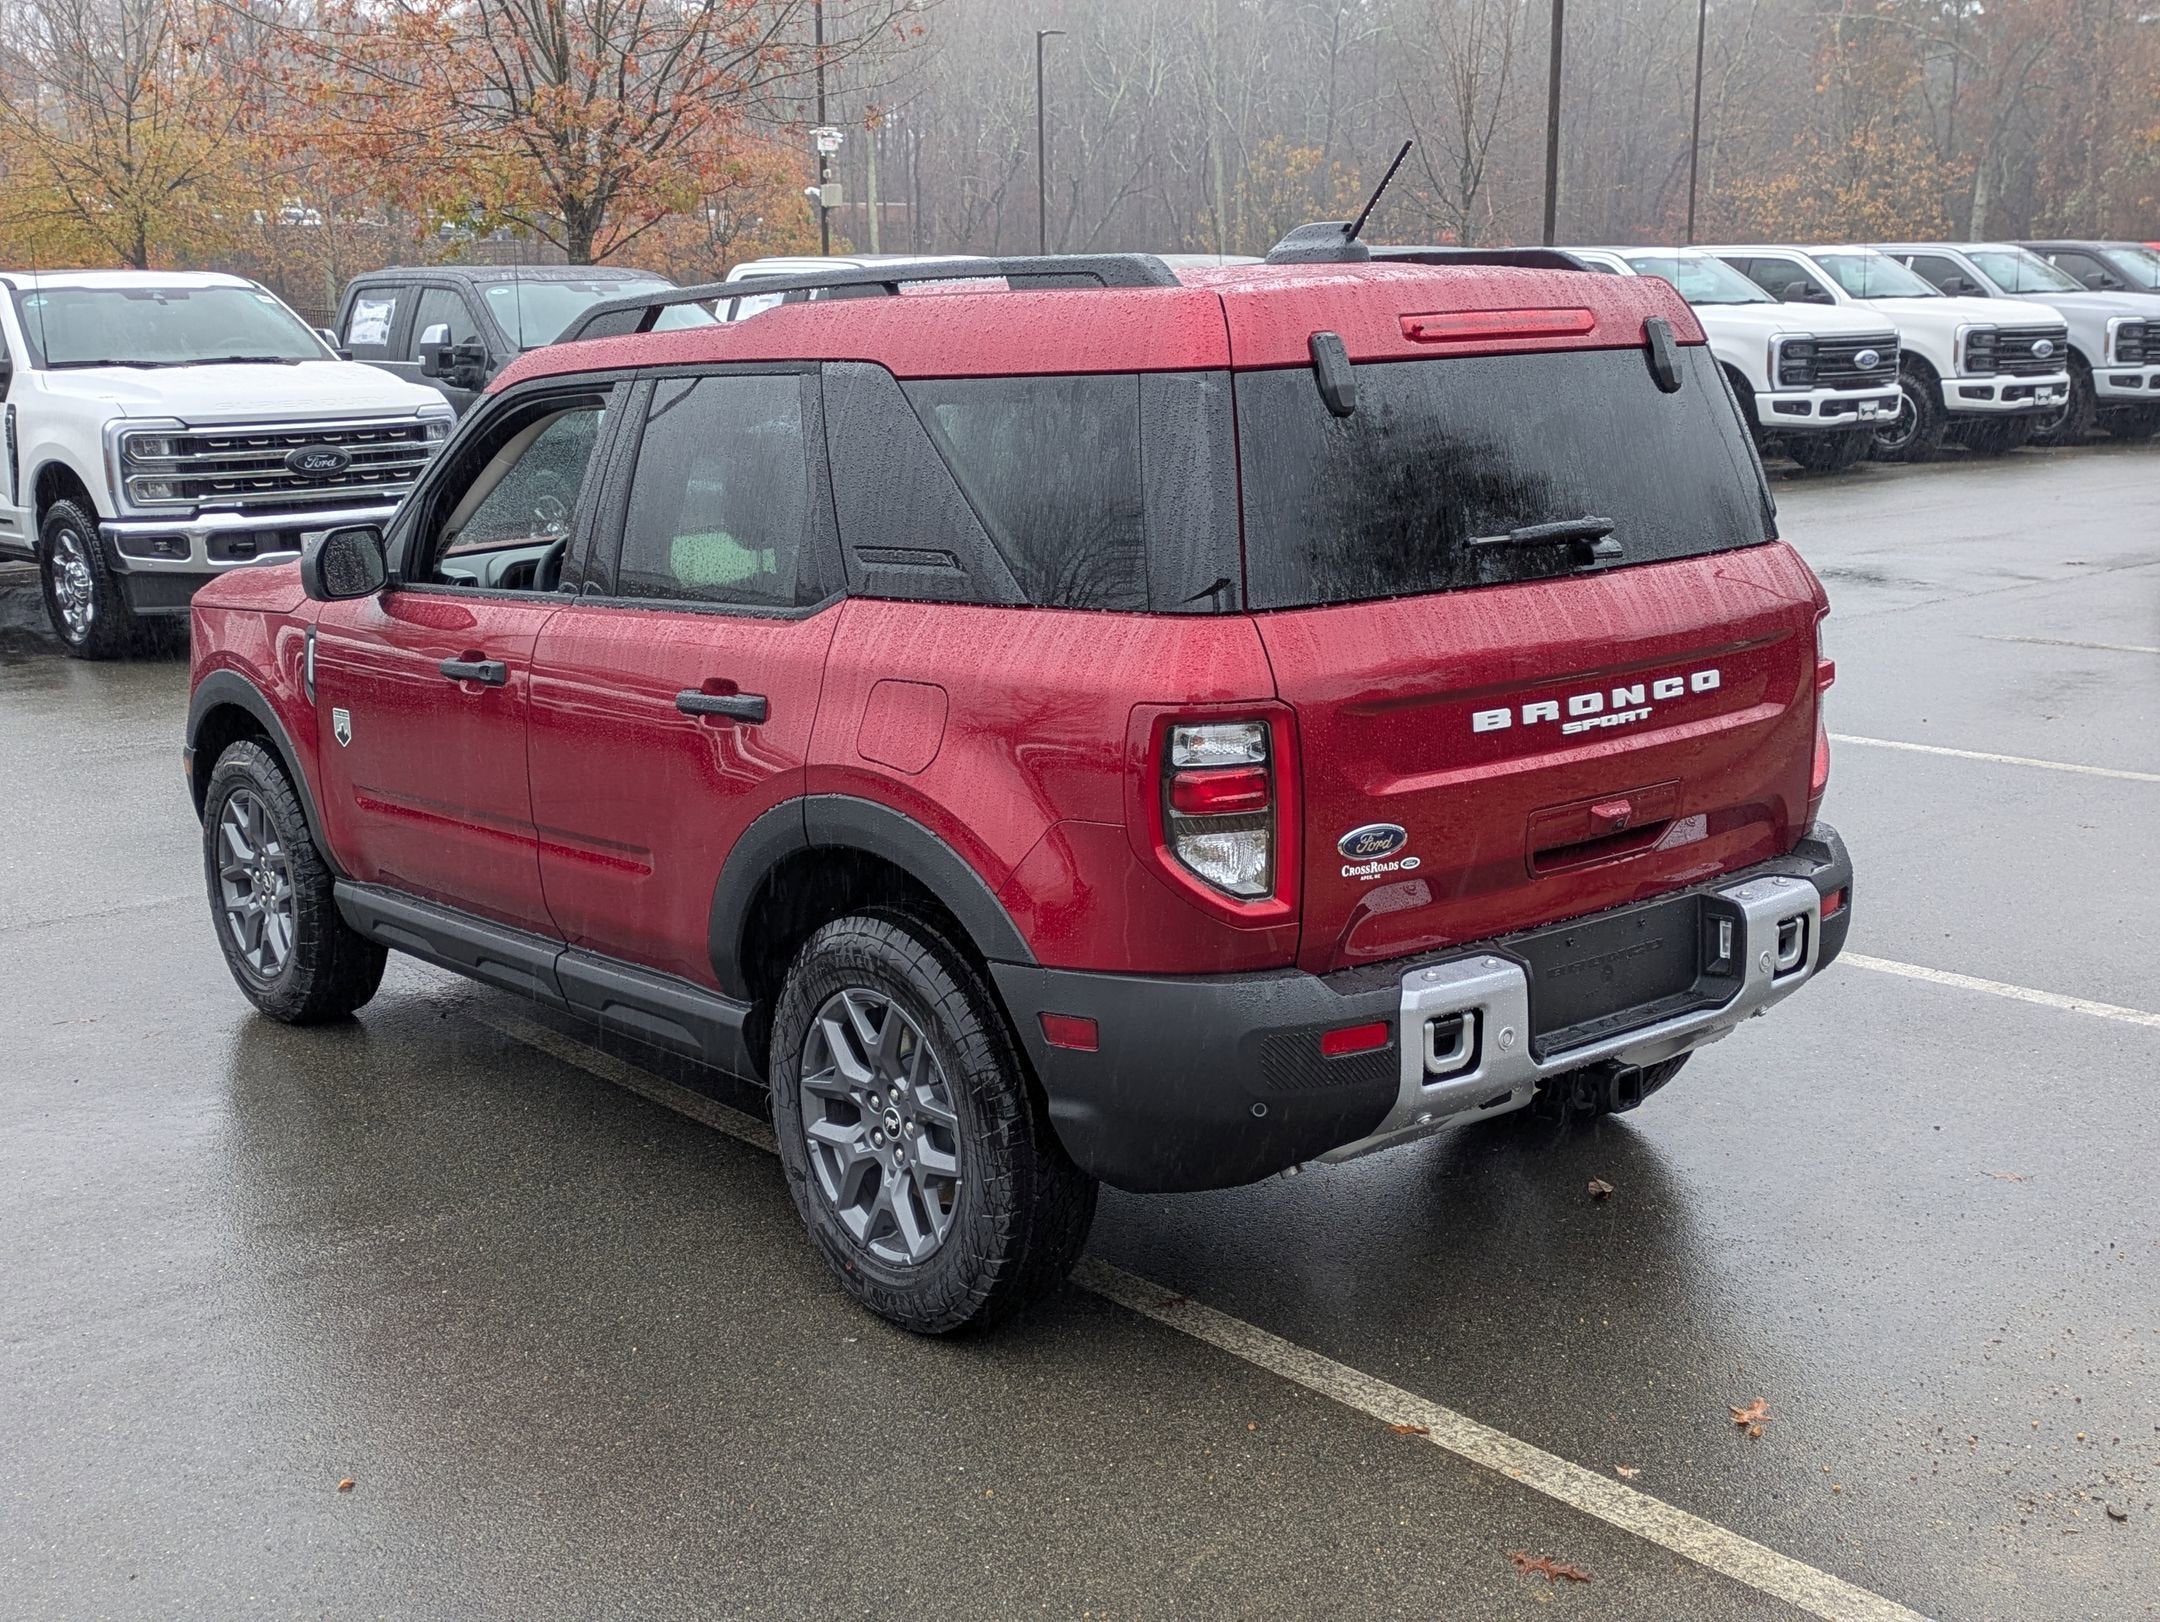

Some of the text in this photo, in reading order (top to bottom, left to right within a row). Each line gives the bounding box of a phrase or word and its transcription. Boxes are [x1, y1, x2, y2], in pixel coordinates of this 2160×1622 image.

[304, 454, 337, 469] Ford
[1472, 669, 1720, 733] BRONCO
[1562, 707, 1653, 735] SPORT
[1356, 831, 1394, 854] Ford
